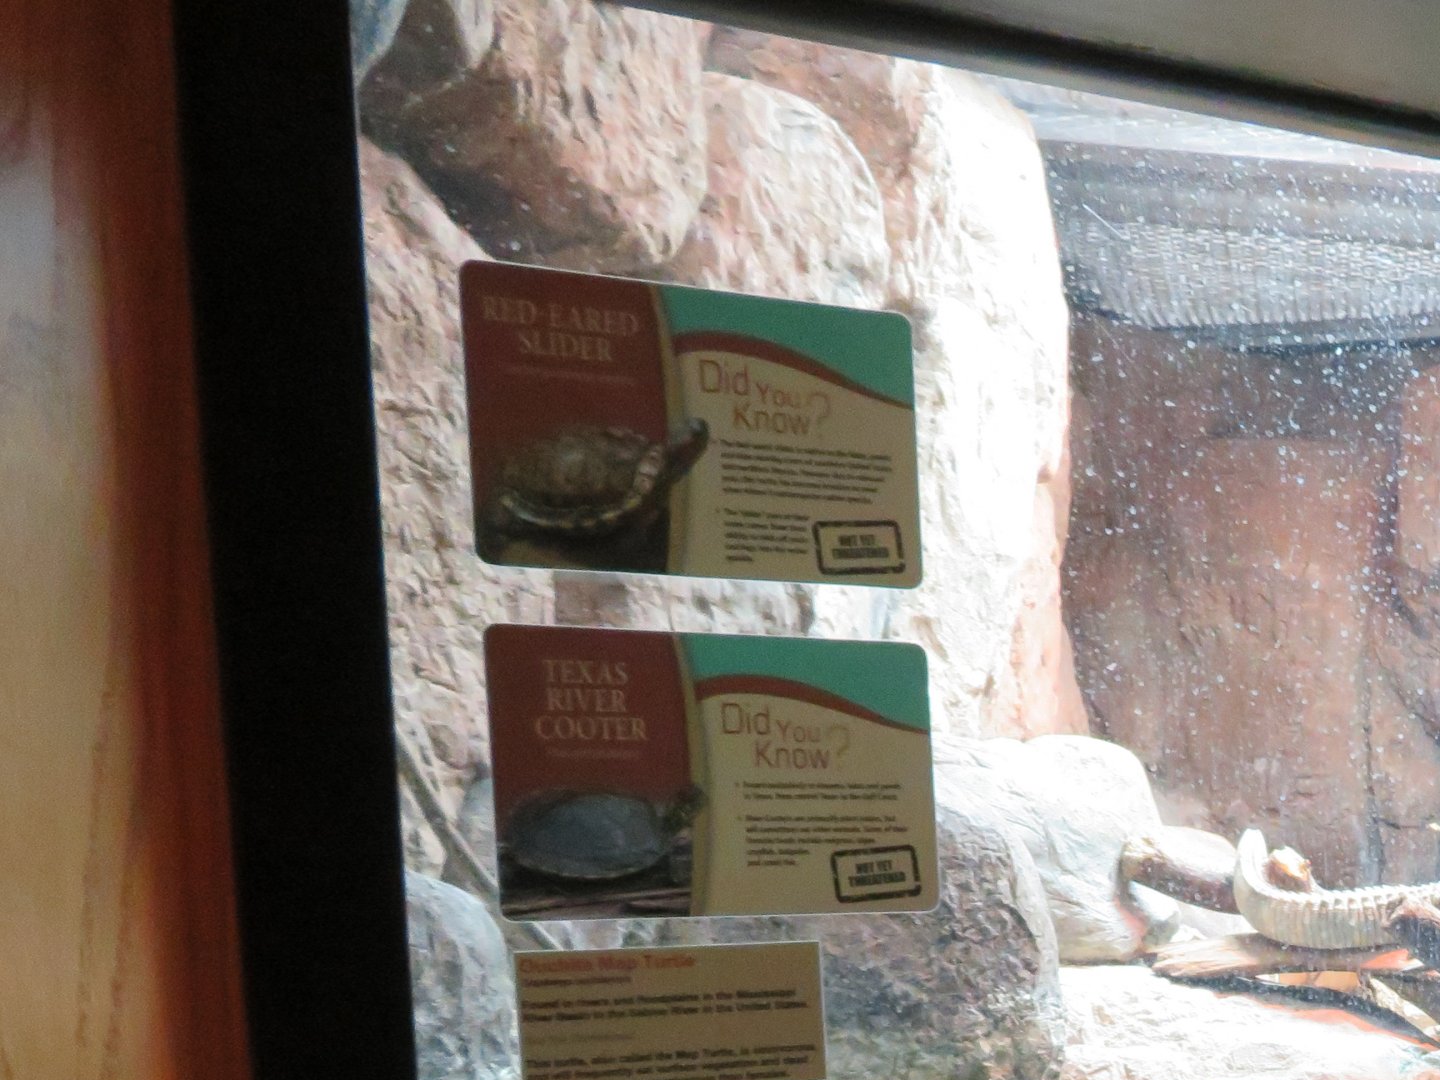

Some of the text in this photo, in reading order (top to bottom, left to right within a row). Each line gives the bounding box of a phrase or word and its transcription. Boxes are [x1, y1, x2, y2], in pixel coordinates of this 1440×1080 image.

[482, 295, 640, 336] RED-EARED
[517, 327, 613, 362] SLIDER
[699, 359, 803, 409] Did You
[541, 658, 630, 685] TEXAS
[545, 686, 627, 713] RIVER
[534, 714, 651, 742] COOTER
[721, 702, 822, 743] Did You
